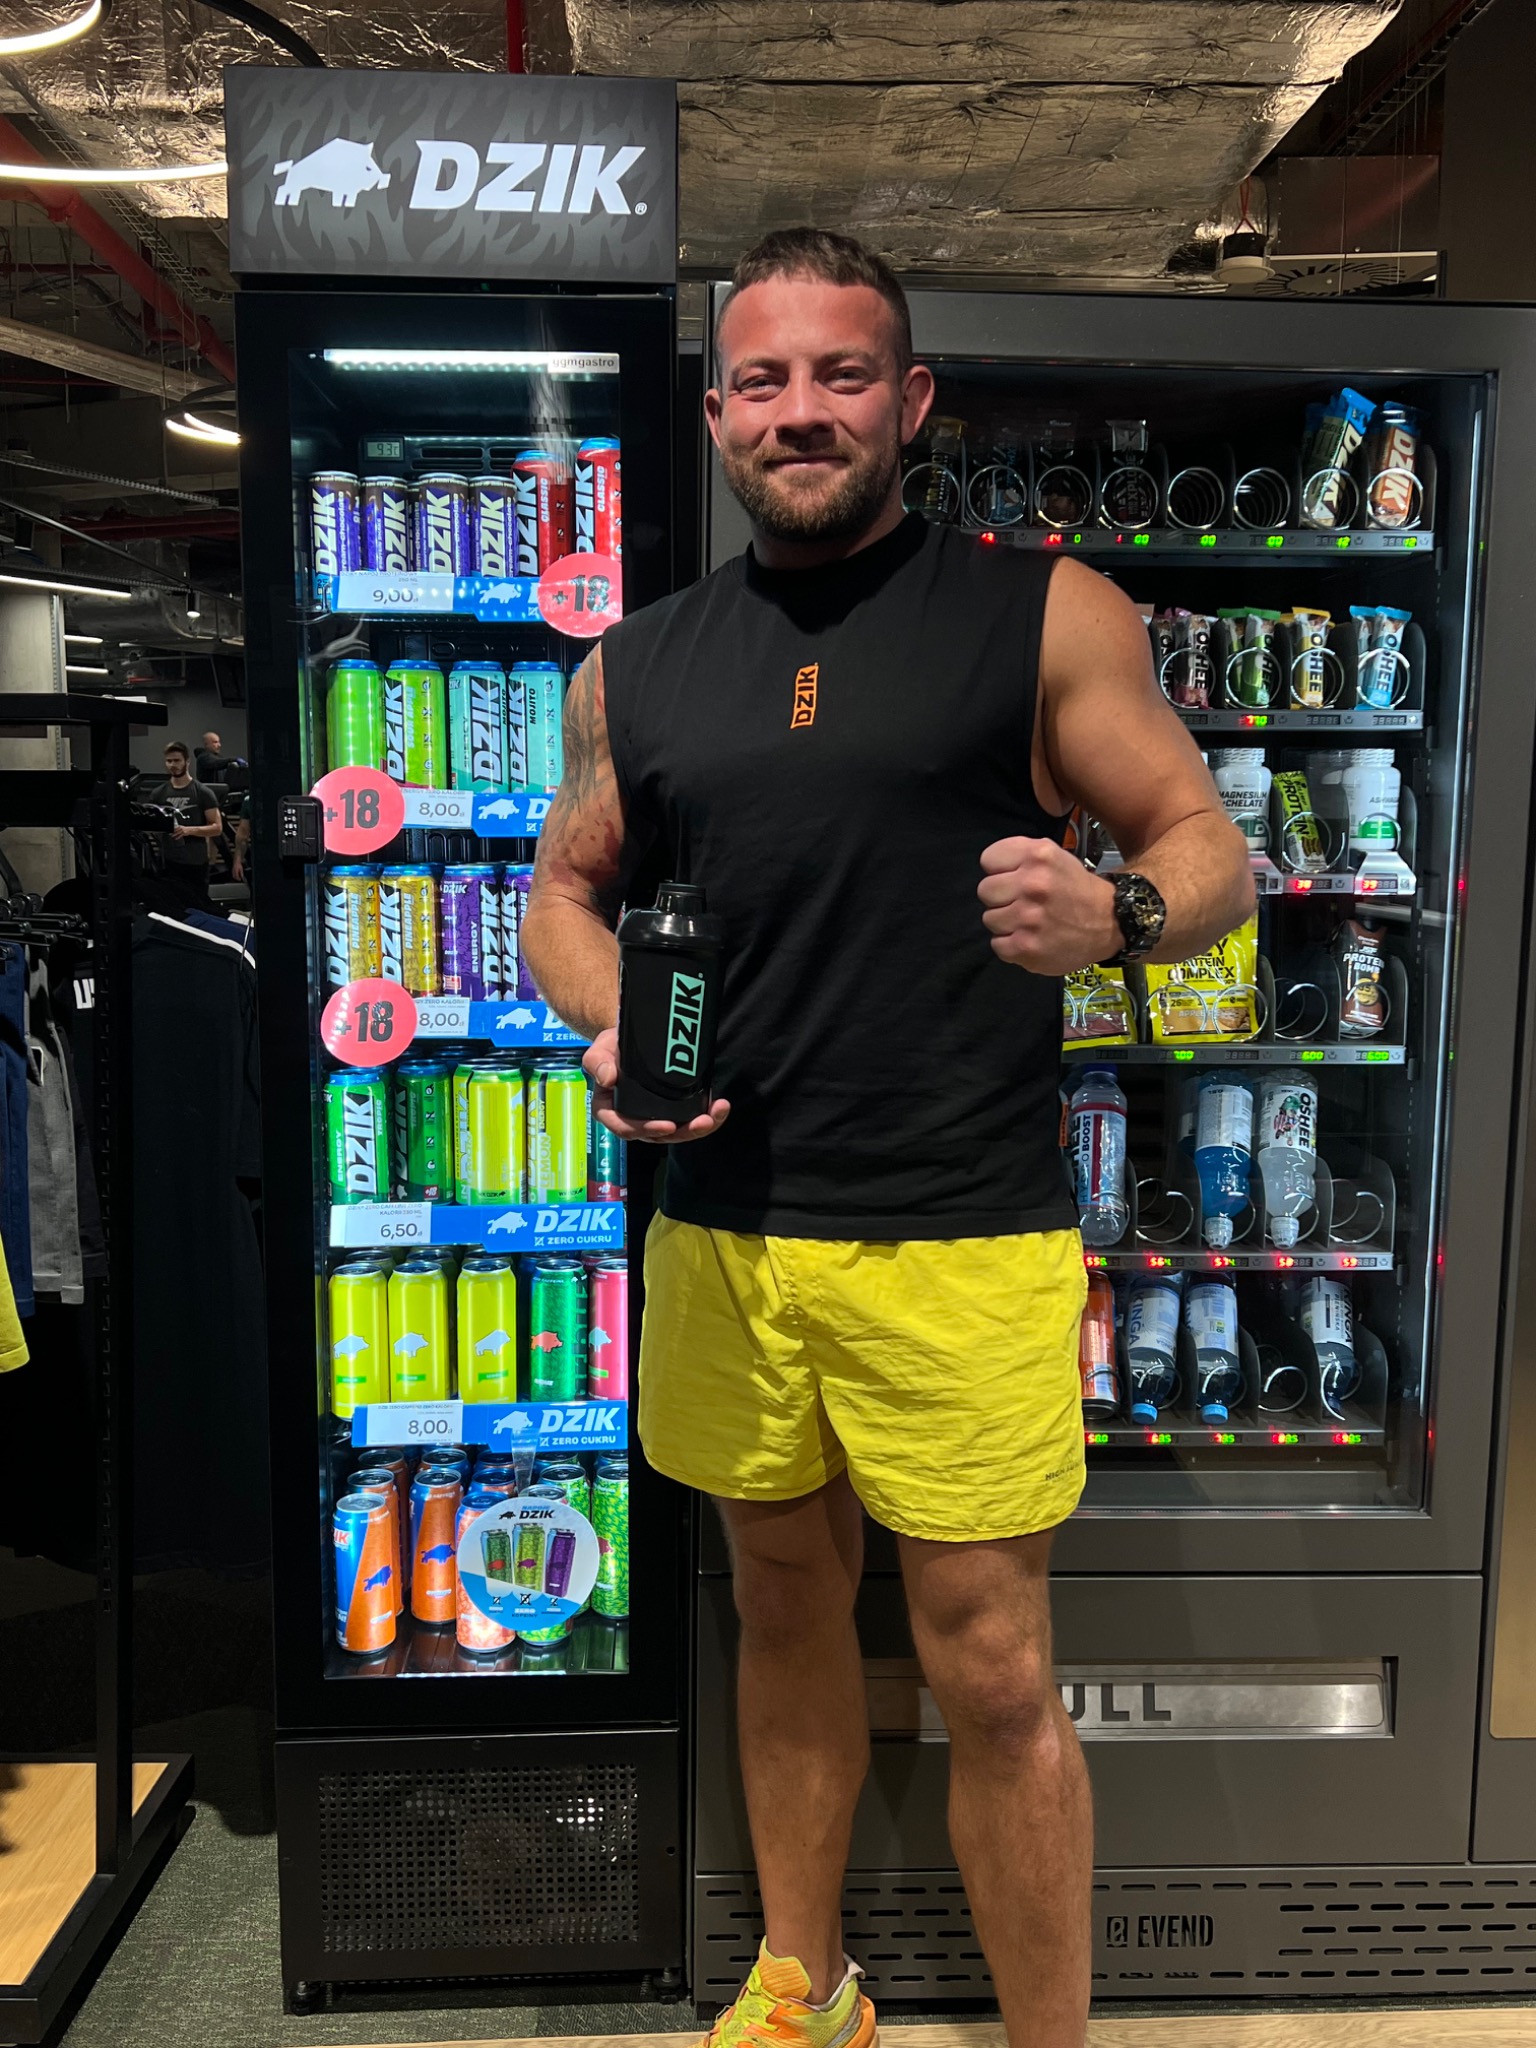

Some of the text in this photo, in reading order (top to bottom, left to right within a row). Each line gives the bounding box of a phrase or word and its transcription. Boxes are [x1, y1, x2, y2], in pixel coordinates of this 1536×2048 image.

[540, 478, 549, 523] CLASSIC
[597, 466, 605, 512] CLASSIC
[312, 488, 338, 576] DZIK
[383, 492, 407, 572] DZIK
[426, 489, 451, 573] DZIK
[480, 492, 504, 577] DZIK
[513, 472, 539, 576] DZIK
[552, 575, 609, 612] +18
[793, 667, 817, 727] DZIK
[385, 680, 404, 781] DZIK
[471, 679, 501, 782] DZIK
[509, 683, 526, 783] DZIK
[323, 789, 380, 828] +18
[1281, 776, 1310, 836] PROTEIN
[443, 884, 467, 893] DZIK
[324, 885, 348, 985] DZIK
[379, 885, 402, 986] DZIK
[481, 882, 501, 983] DZIK
[501, 889, 518, 986] DZIK
[1168, 967, 1235, 981] COMPLEX
[1354, 962, 1380, 973] BOMB
[336, 1001, 394, 1042] +18
[667, 974, 704, 1074] DZIK
[1171, 999, 1182, 1007] 26
[344, 1093, 376, 1194] DZIK
[1082, 1115, 1091, 1152] BOOST
[1299, 1092, 1311, 1149] OSHEE
[540, 1136, 551, 1188] LEMON
[381, 1223, 417, 1239] 6,50
[547, 1235, 612, 1244] ZERO CUKRU
[408, 1420, 448, 1436] 8,00
[552, 1436, 616, 1445] ZERO CUKRU
[520, 1510, 555, 1519] DZIK
[1138, 1914, 1214, 1948] EVEND
